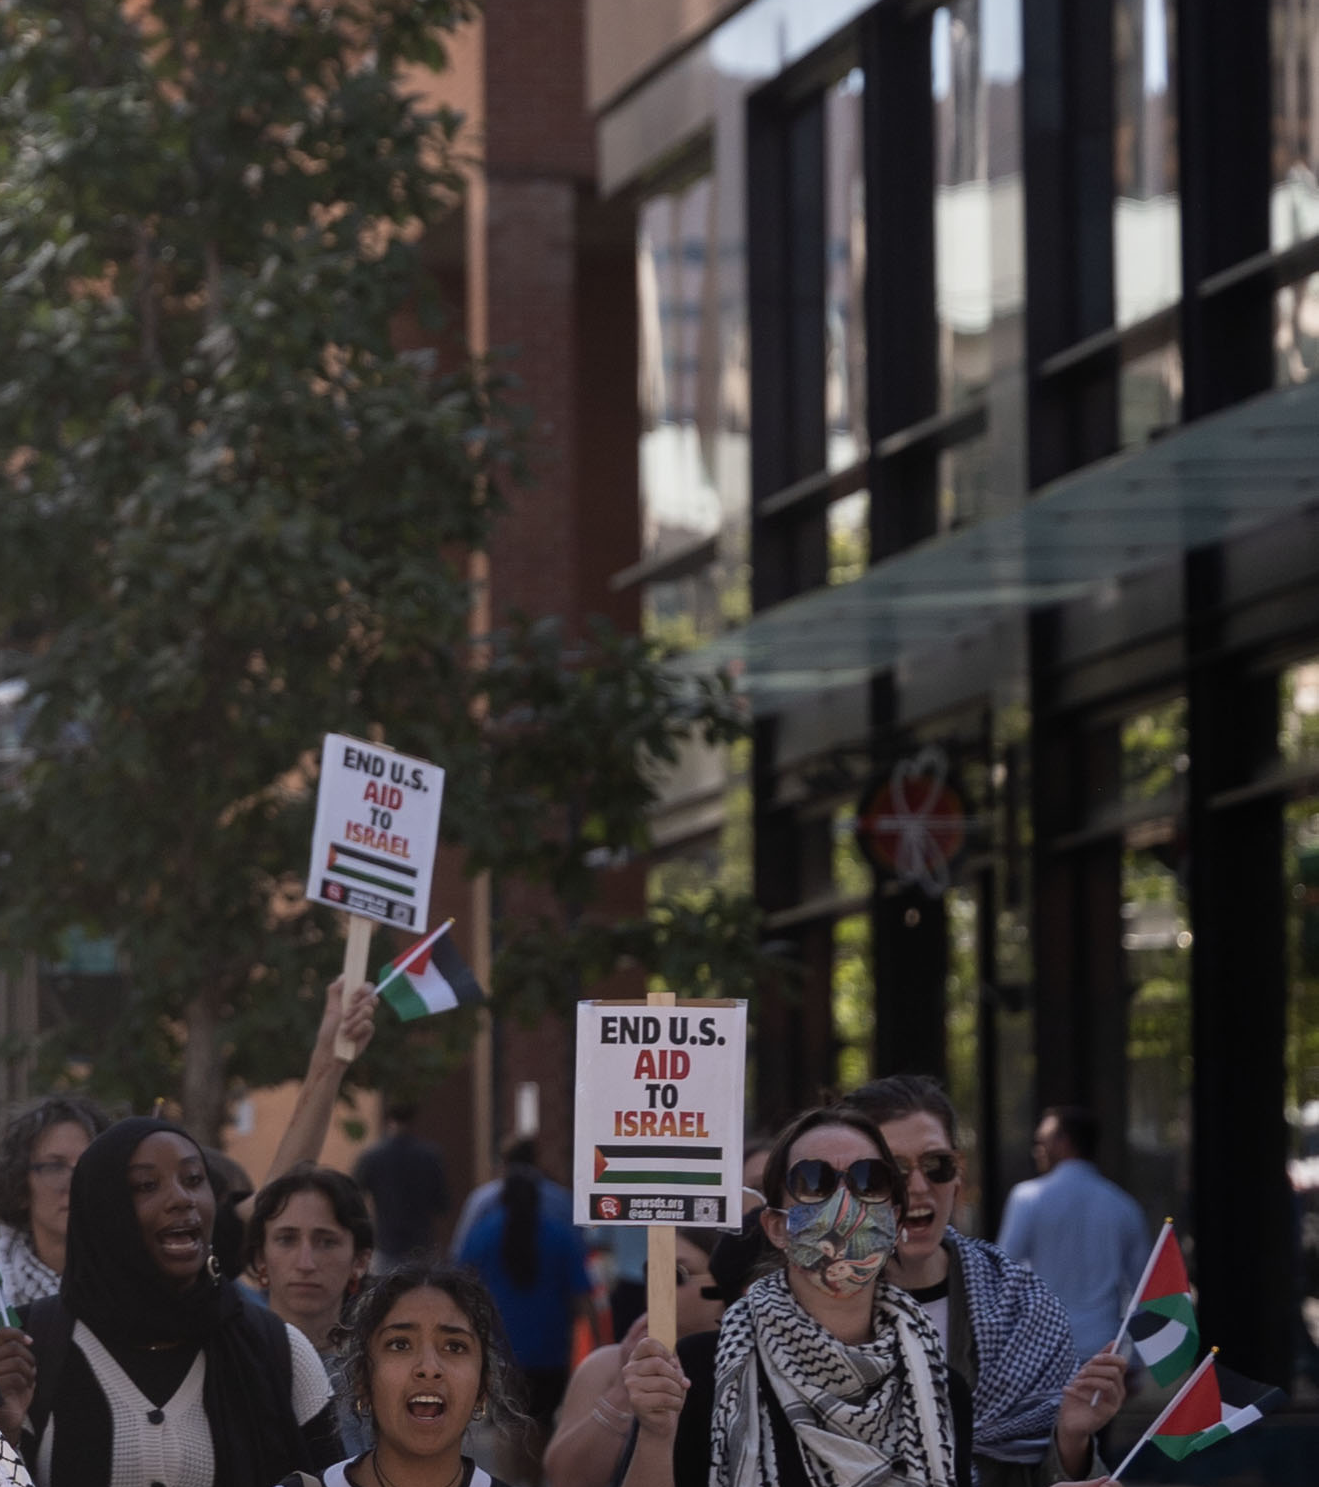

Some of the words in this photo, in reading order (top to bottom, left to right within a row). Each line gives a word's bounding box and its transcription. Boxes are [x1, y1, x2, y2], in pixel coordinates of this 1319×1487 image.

[342, 746, 385, 778] END
[391, 761, 429, 793] U.S.
[363, 780, 404, 811] AID
[370, 807, 393, 830] TO
[345, 820, 411, 859] ISRAEL
[600, 1016, 661, 1044] END
[669, 1016, 726, 1046] U.S.
[634, 1049, 691, 1080] AID
[645, 1083, 678, 1109] TO
[614, 1110, 709, 1138] ISRAEL
[630, 1197, 684, 1210] newsds.org
